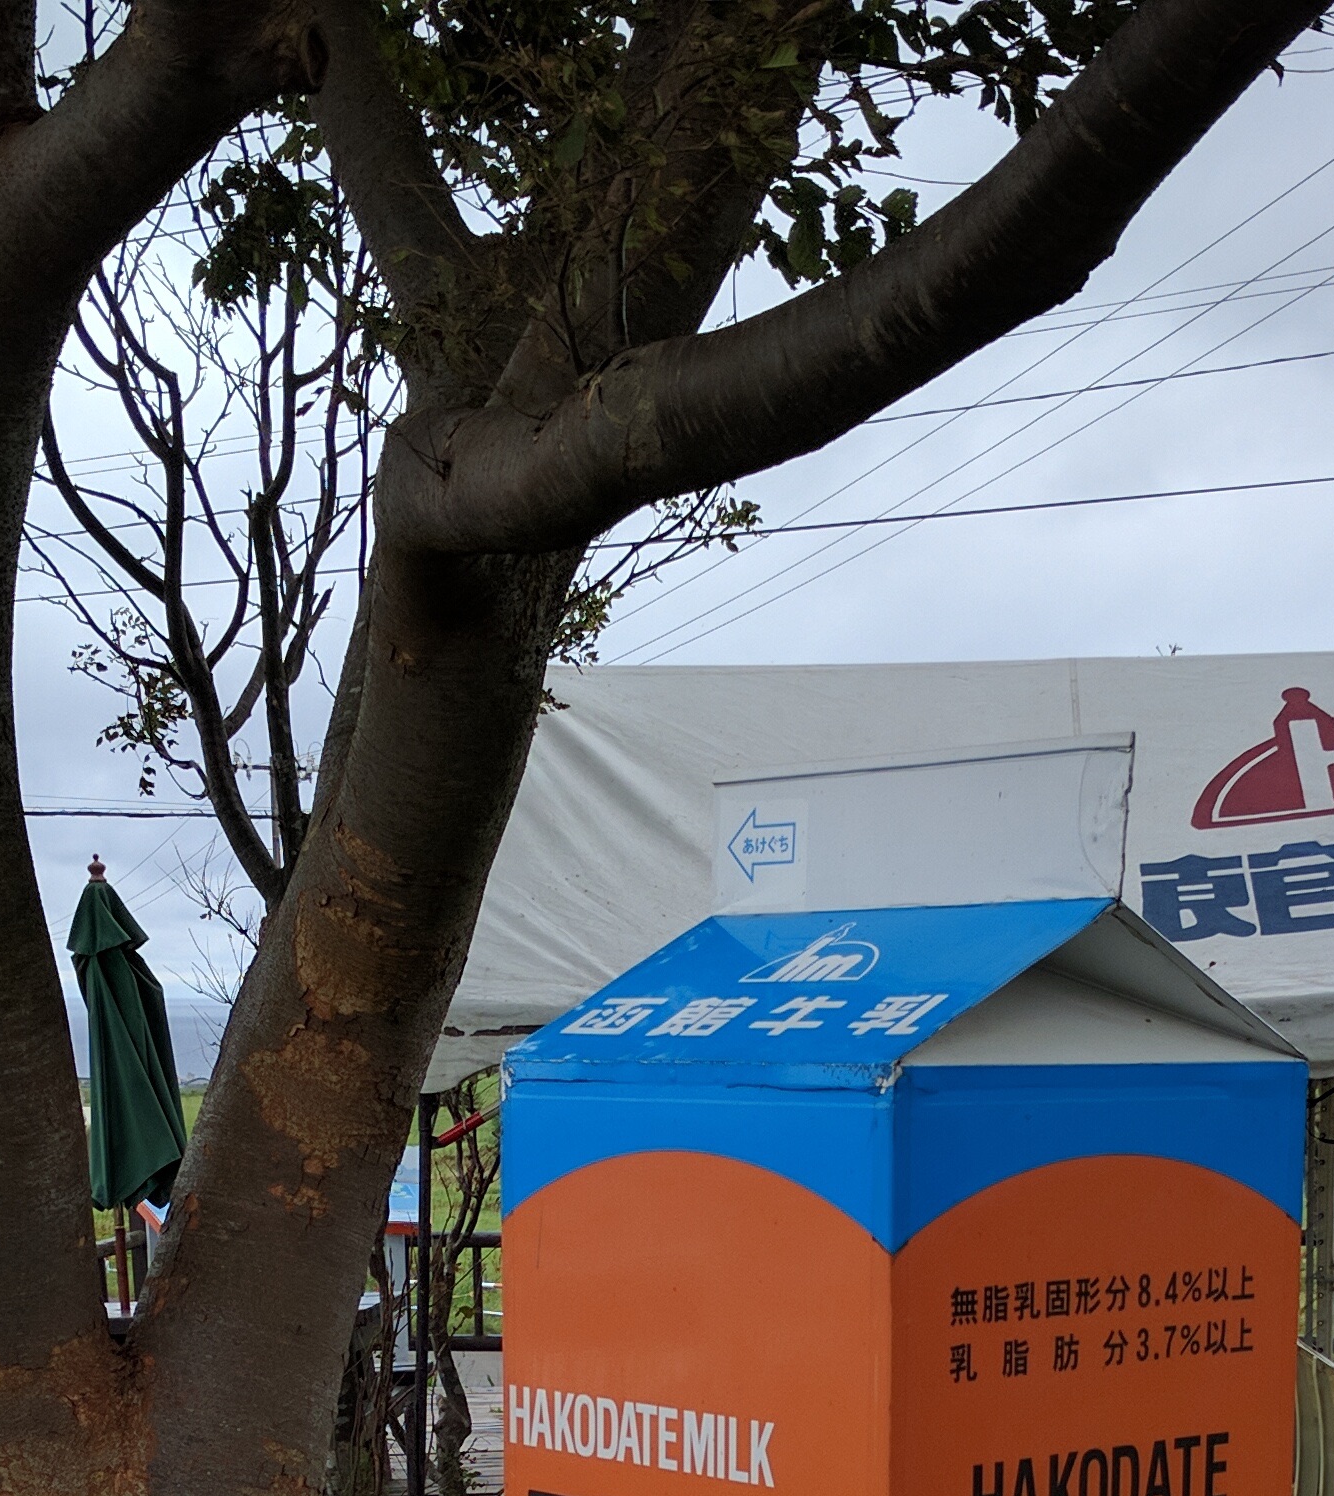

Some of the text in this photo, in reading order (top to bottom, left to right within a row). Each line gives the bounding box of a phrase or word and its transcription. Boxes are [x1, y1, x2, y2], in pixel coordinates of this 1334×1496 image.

[742, 834, 790, 855] あけぐち
[561, 994, 949, 1037] 函館牛乳
